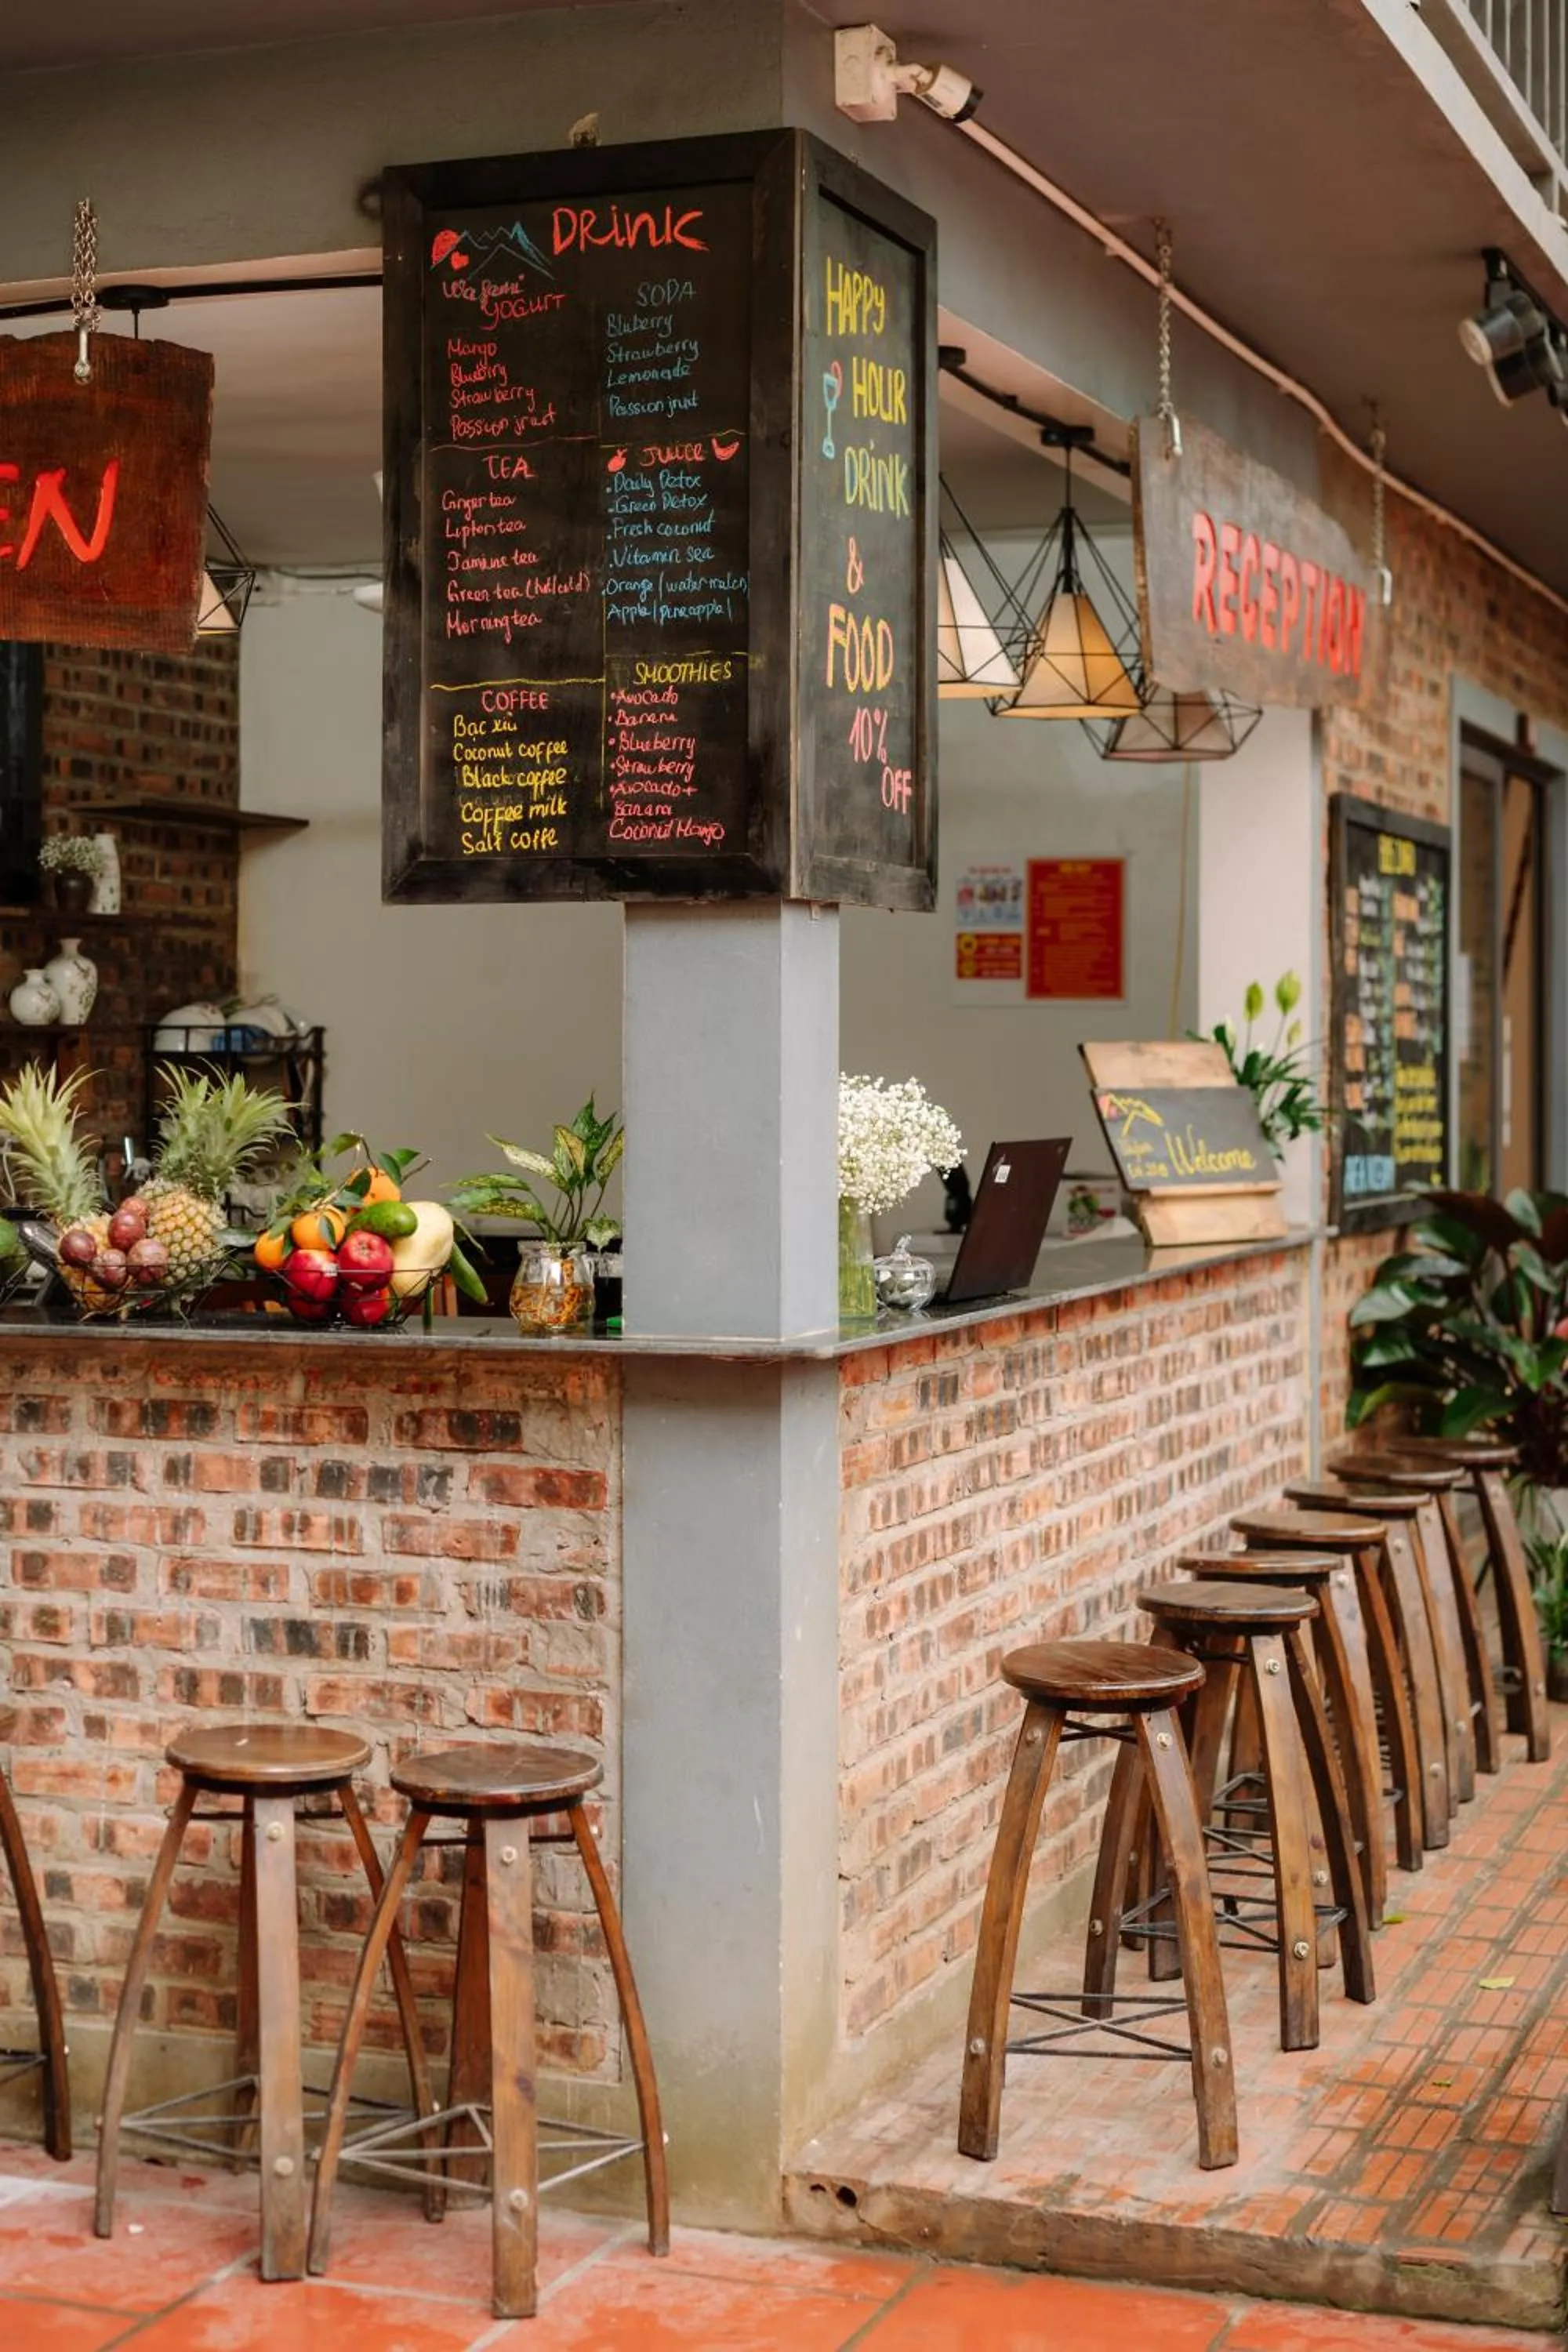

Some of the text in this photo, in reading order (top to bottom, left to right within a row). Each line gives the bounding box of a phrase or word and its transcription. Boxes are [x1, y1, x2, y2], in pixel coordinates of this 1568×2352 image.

[636, 278, 696, 307] SODA
[606, 339, 699, 363] Strawberry
[606, 358, 691, 389] Lemonade
[852, 356, 907, 426] HOUR
[482, 455, 536, 480] TEA
[615, 491, 707, 514] Green Detox
[612, 517, 653, 539] Fresh
[511, 547, 539, 566] tea
[614, 544, 681, 568] Vitamin
[847, 537, 864, 594] &
[447, 579, 491, 603] Green
[493, 583, 523, 601] tea
[1192, 509, 1367, 680] RECEPTION
[514, 608, 543, 626] tea
[826, 603, 894, 693] FOOD
[482, 690, 550, 712] COFFEE
[849, 706, 887, 765] 10%
[452, 741, 514, 762] Coconut
[462, 764, 514, 789] Black
[881, 765, 913, 815] OFF
[528, 794, 568, 819] milk
[1164, 1123, 1256, 1176] Welcome
